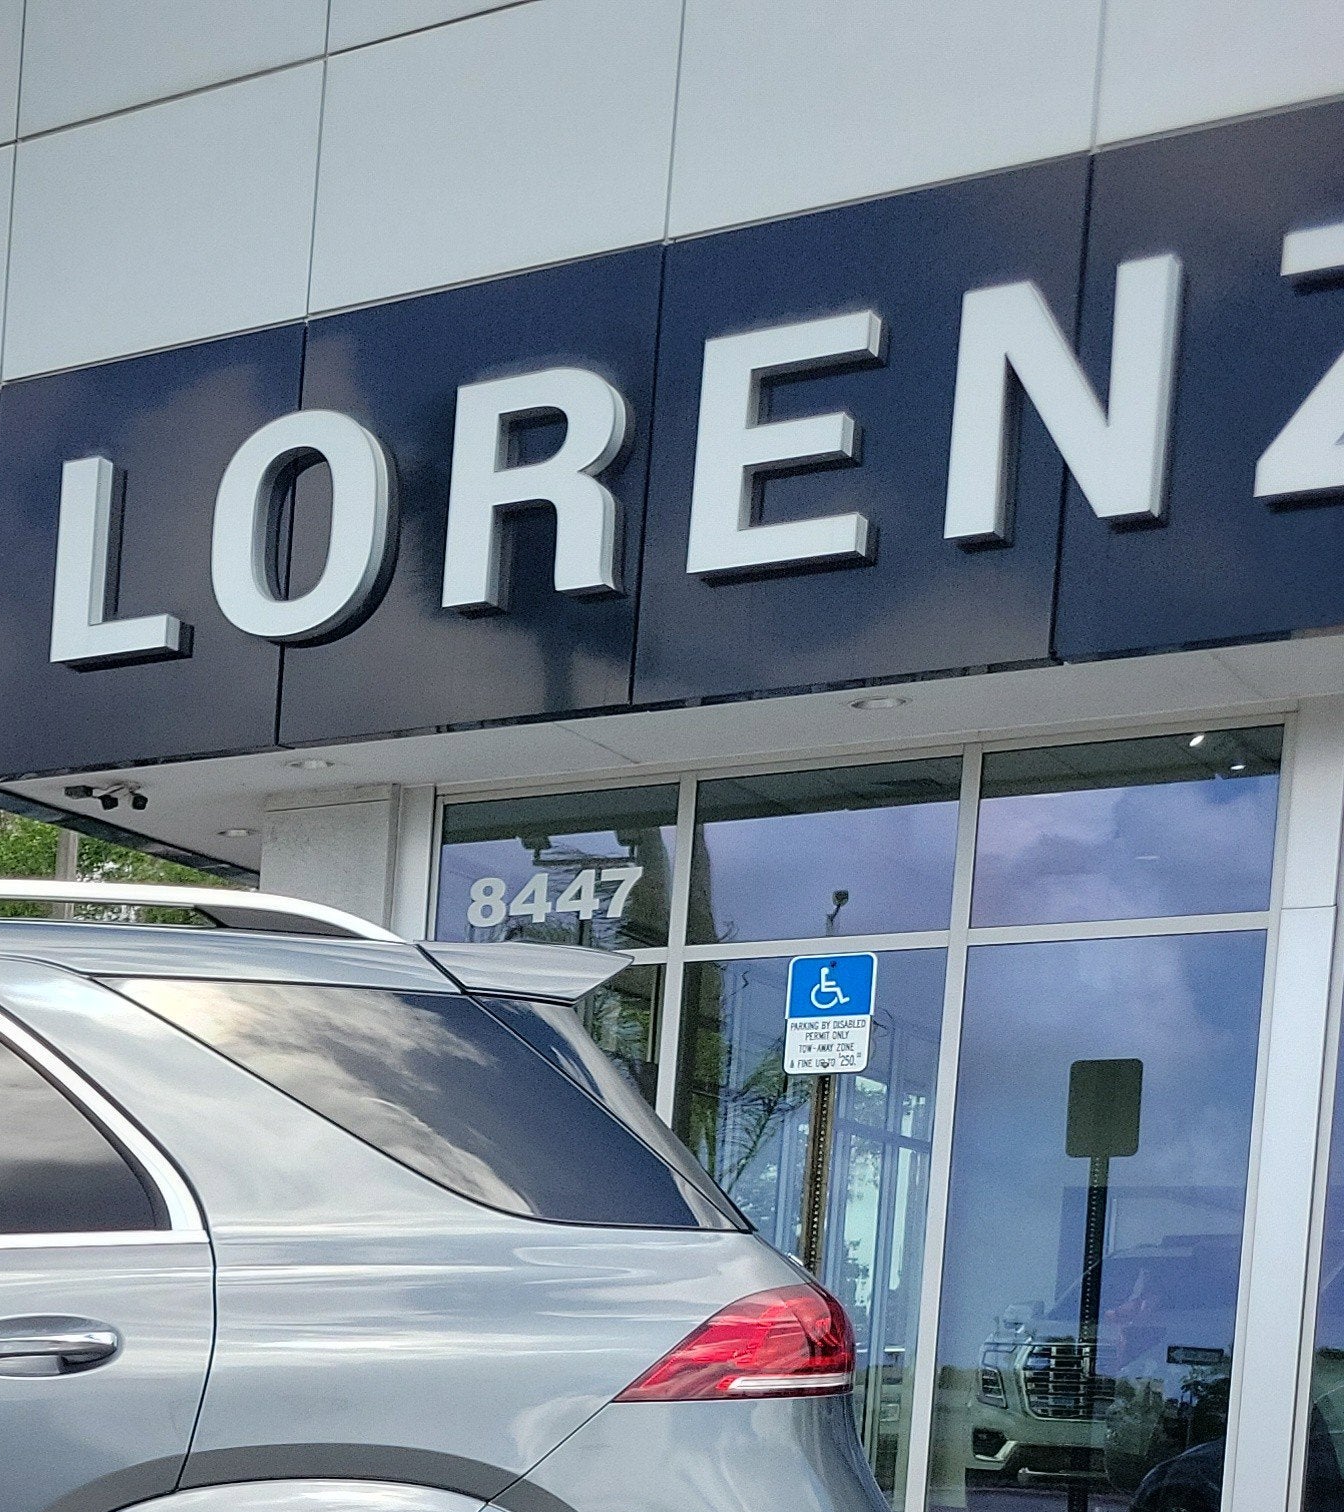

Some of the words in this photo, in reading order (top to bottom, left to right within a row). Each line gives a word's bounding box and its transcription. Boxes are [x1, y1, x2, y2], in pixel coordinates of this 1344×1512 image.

[467, 866, 643, 928] 8447
[790, 1021, 819, 1031] PARKING
[821, 1020, 831, 1030] BY
[833, 1019, 866, 1029] DISABLED
[805, 1031, 830, 1040] PERMIT
[832, 1030, 850, 1040] ONLY
[798, 1043, 834, 1053] TOW-AWAY
[836, 1042, 854, 1052] ZONE
[797, 1059, 812, 1068] FINE
